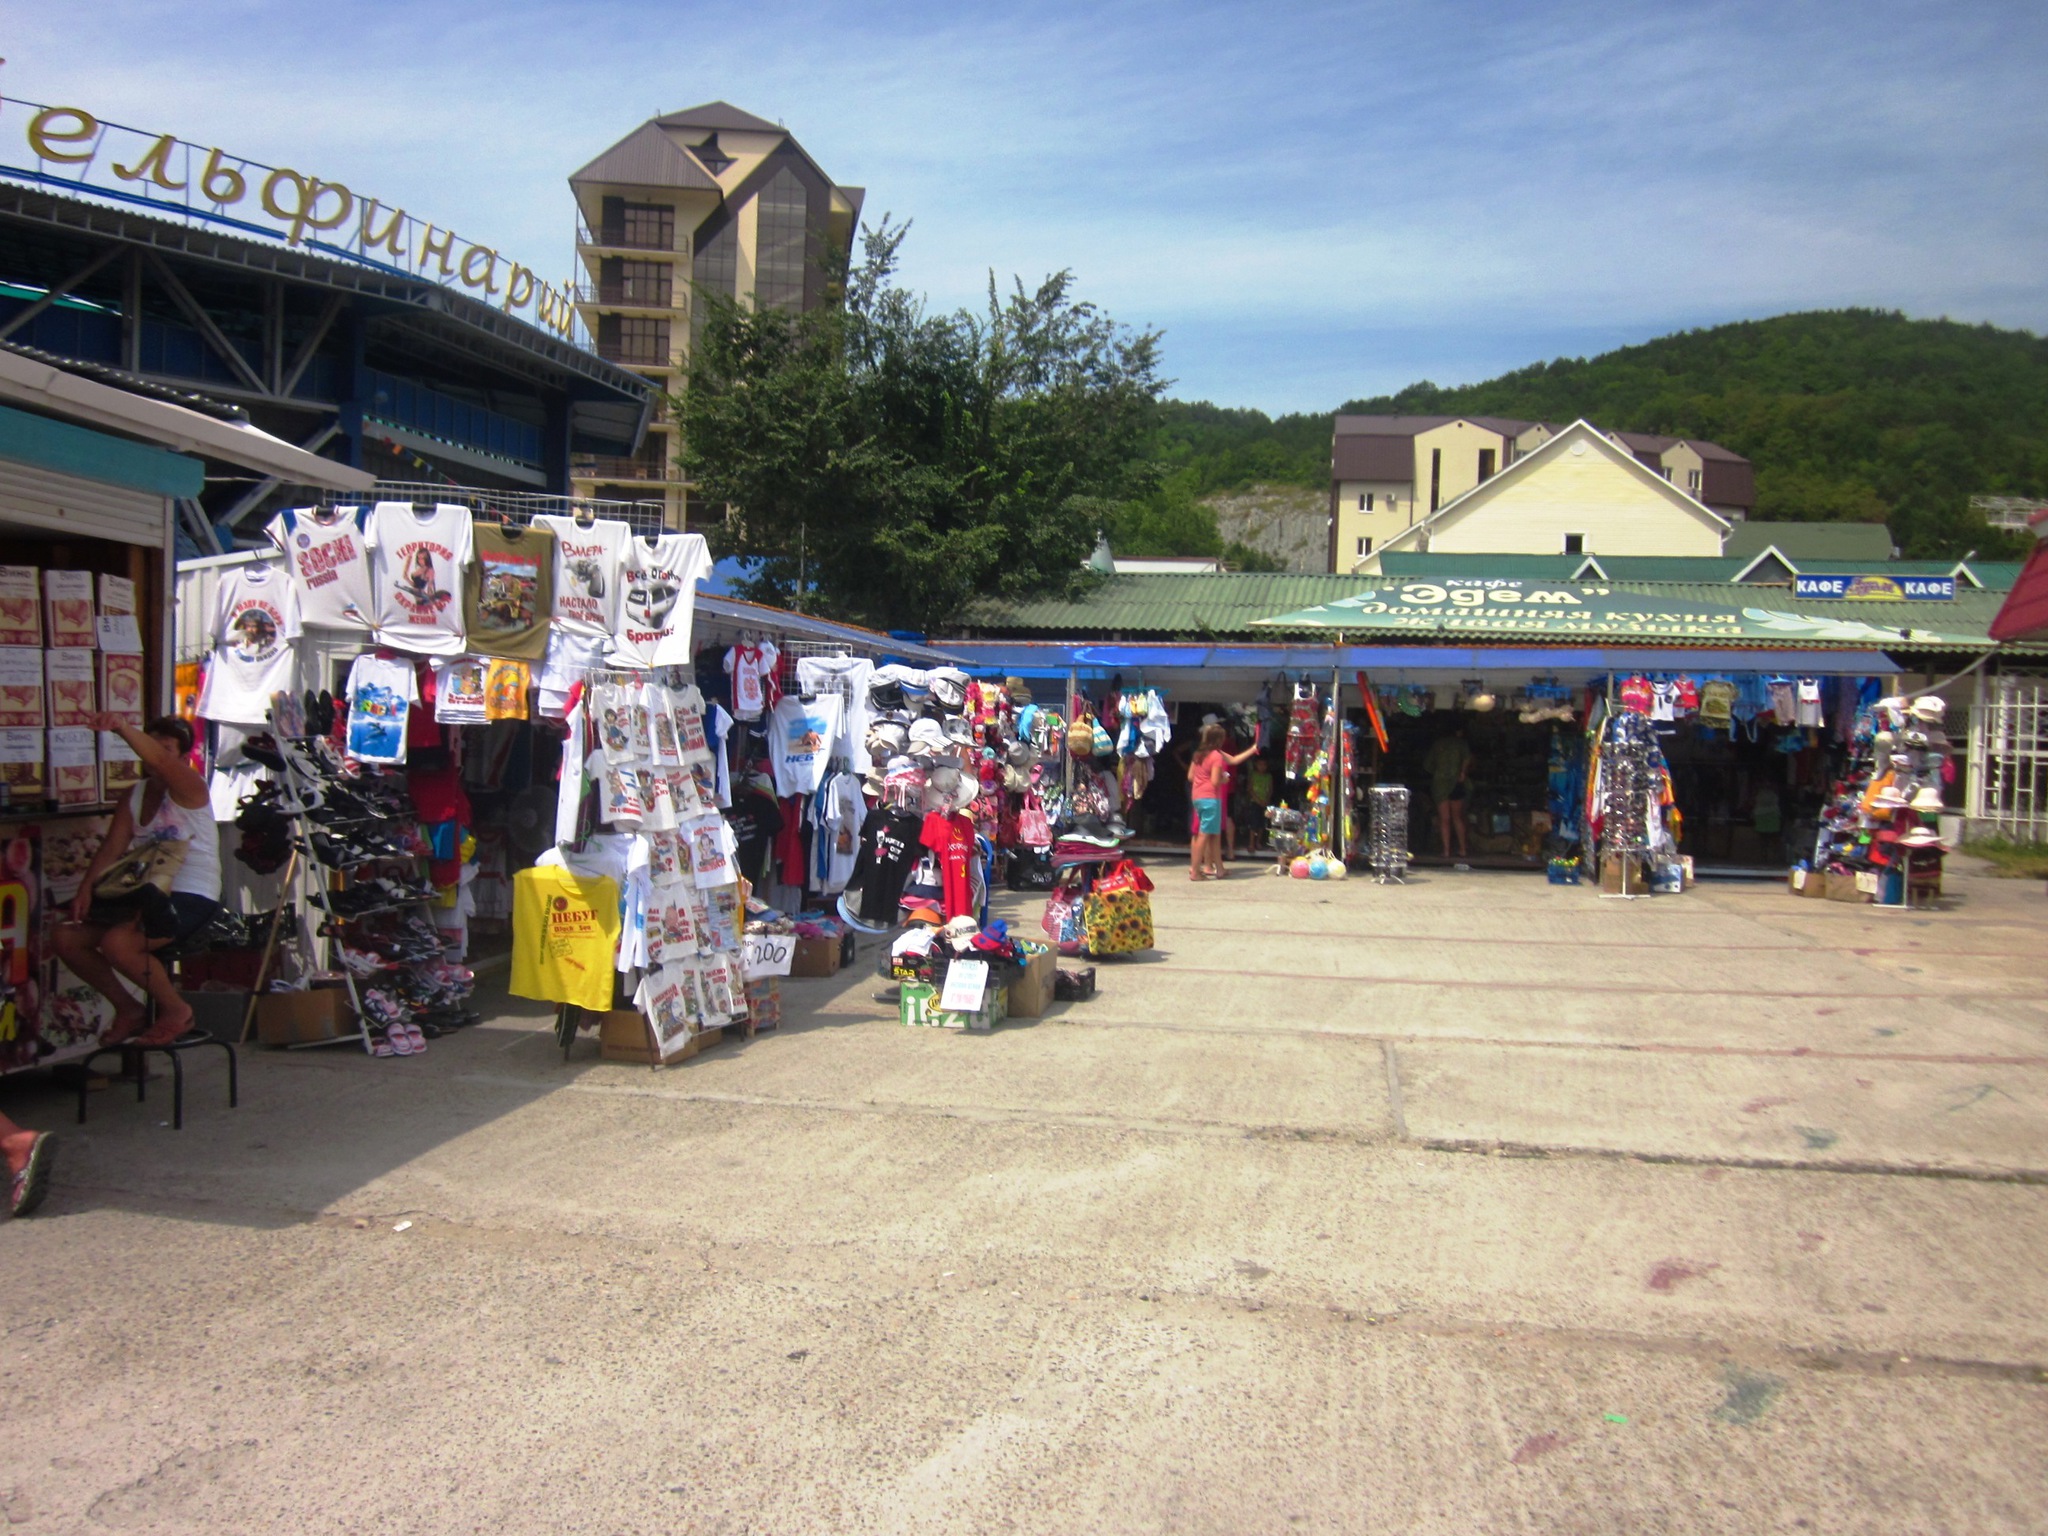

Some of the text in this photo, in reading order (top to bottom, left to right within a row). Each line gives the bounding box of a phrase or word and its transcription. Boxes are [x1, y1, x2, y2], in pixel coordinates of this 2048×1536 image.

[0, 102, 578, 341] ельфинарий
[396, 541, 454, 561] ТЕРРИТОРИЯ
[306, 569, 338, 590] russia
[1446, 578, 1524, 591] кафе
[1796, 579, 1844, 595] КАФЕ
[1904, 581, 1953, 597] КАФЕ
[560, 596, 598, 610] НАСТАЛО
[408, 614, 437, 624] ЖЕНОЙ
[1362, 601, 1738, 625] домашняя кухня
[1557, 620, 1745, 636] музыка
[754, 942, 787, 965] 200
